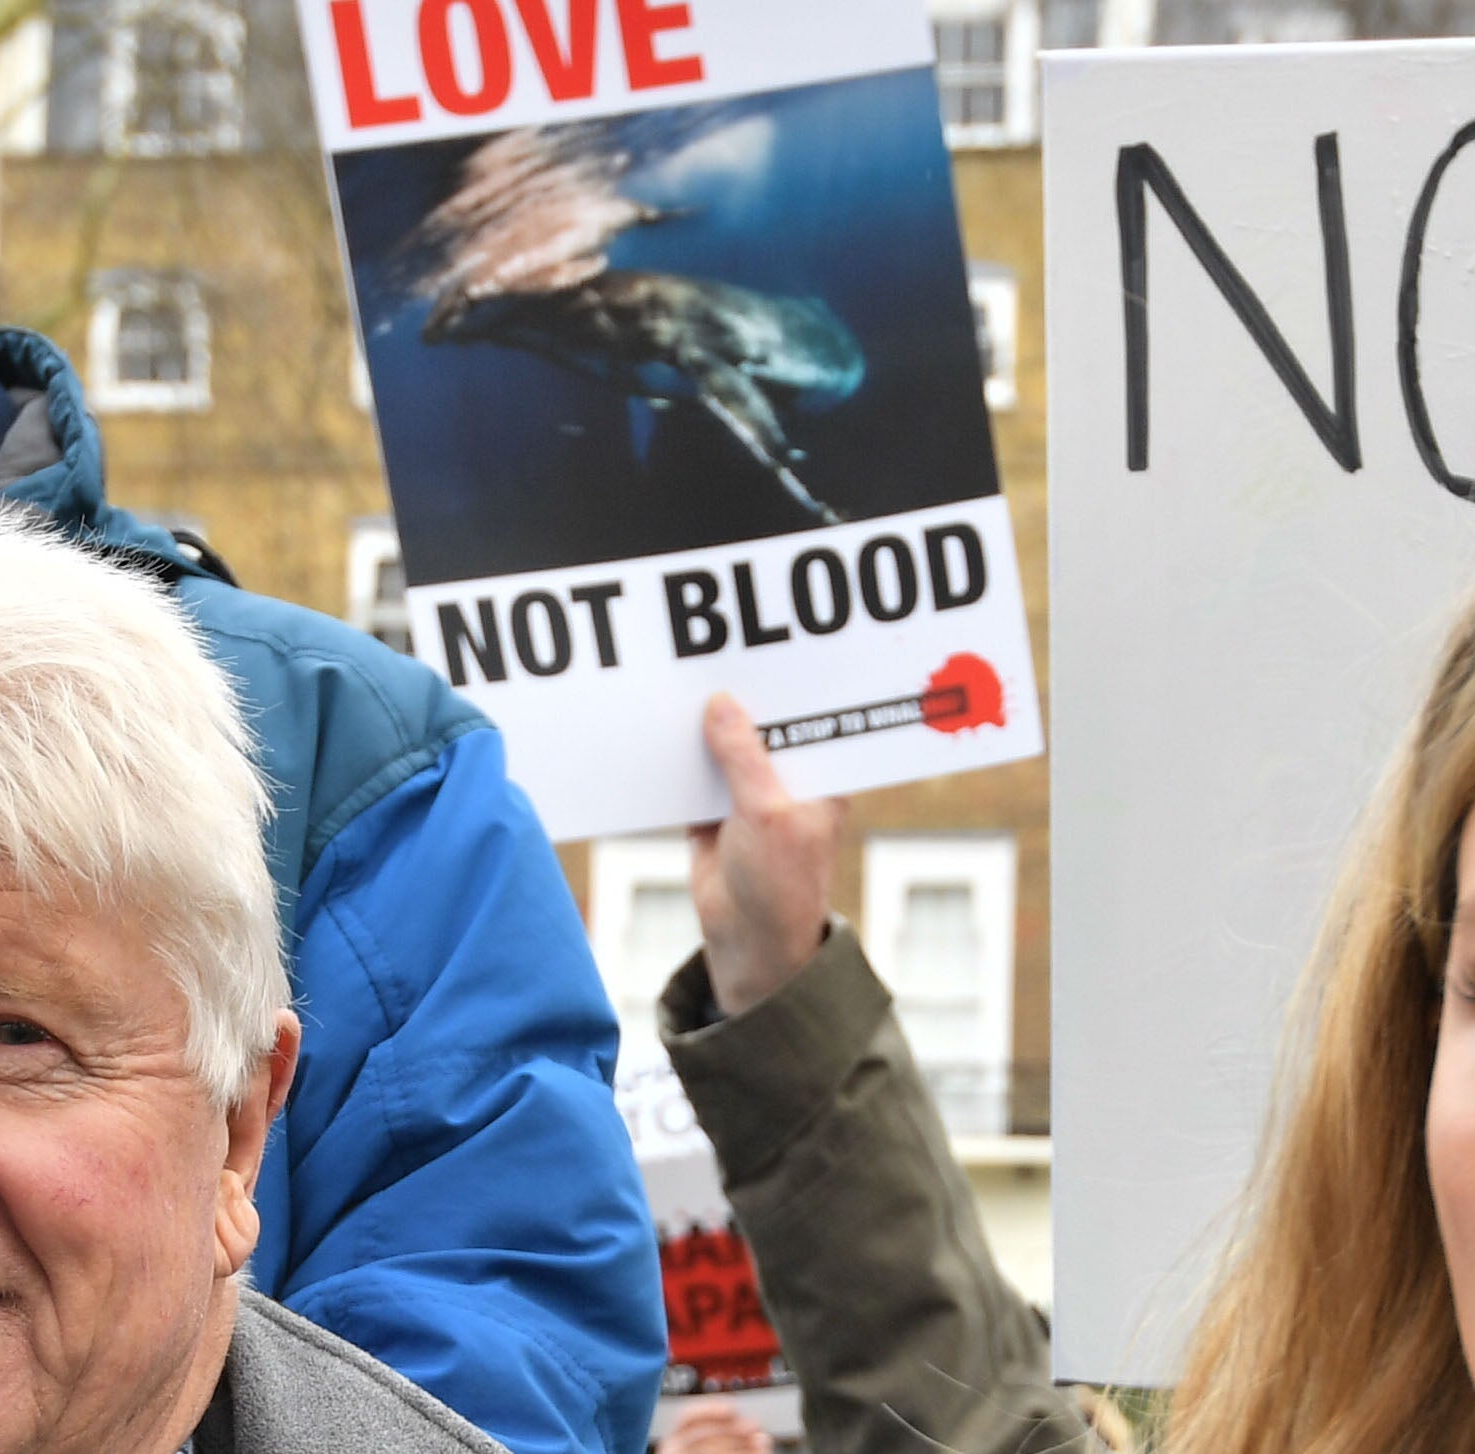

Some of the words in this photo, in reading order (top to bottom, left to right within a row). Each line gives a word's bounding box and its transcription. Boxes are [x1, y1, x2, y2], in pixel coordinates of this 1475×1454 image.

[329, 0, 705, 130] LOVE
[436, 582, 624, 688] NOT
[664, 522, 989, 660] BLOOD
